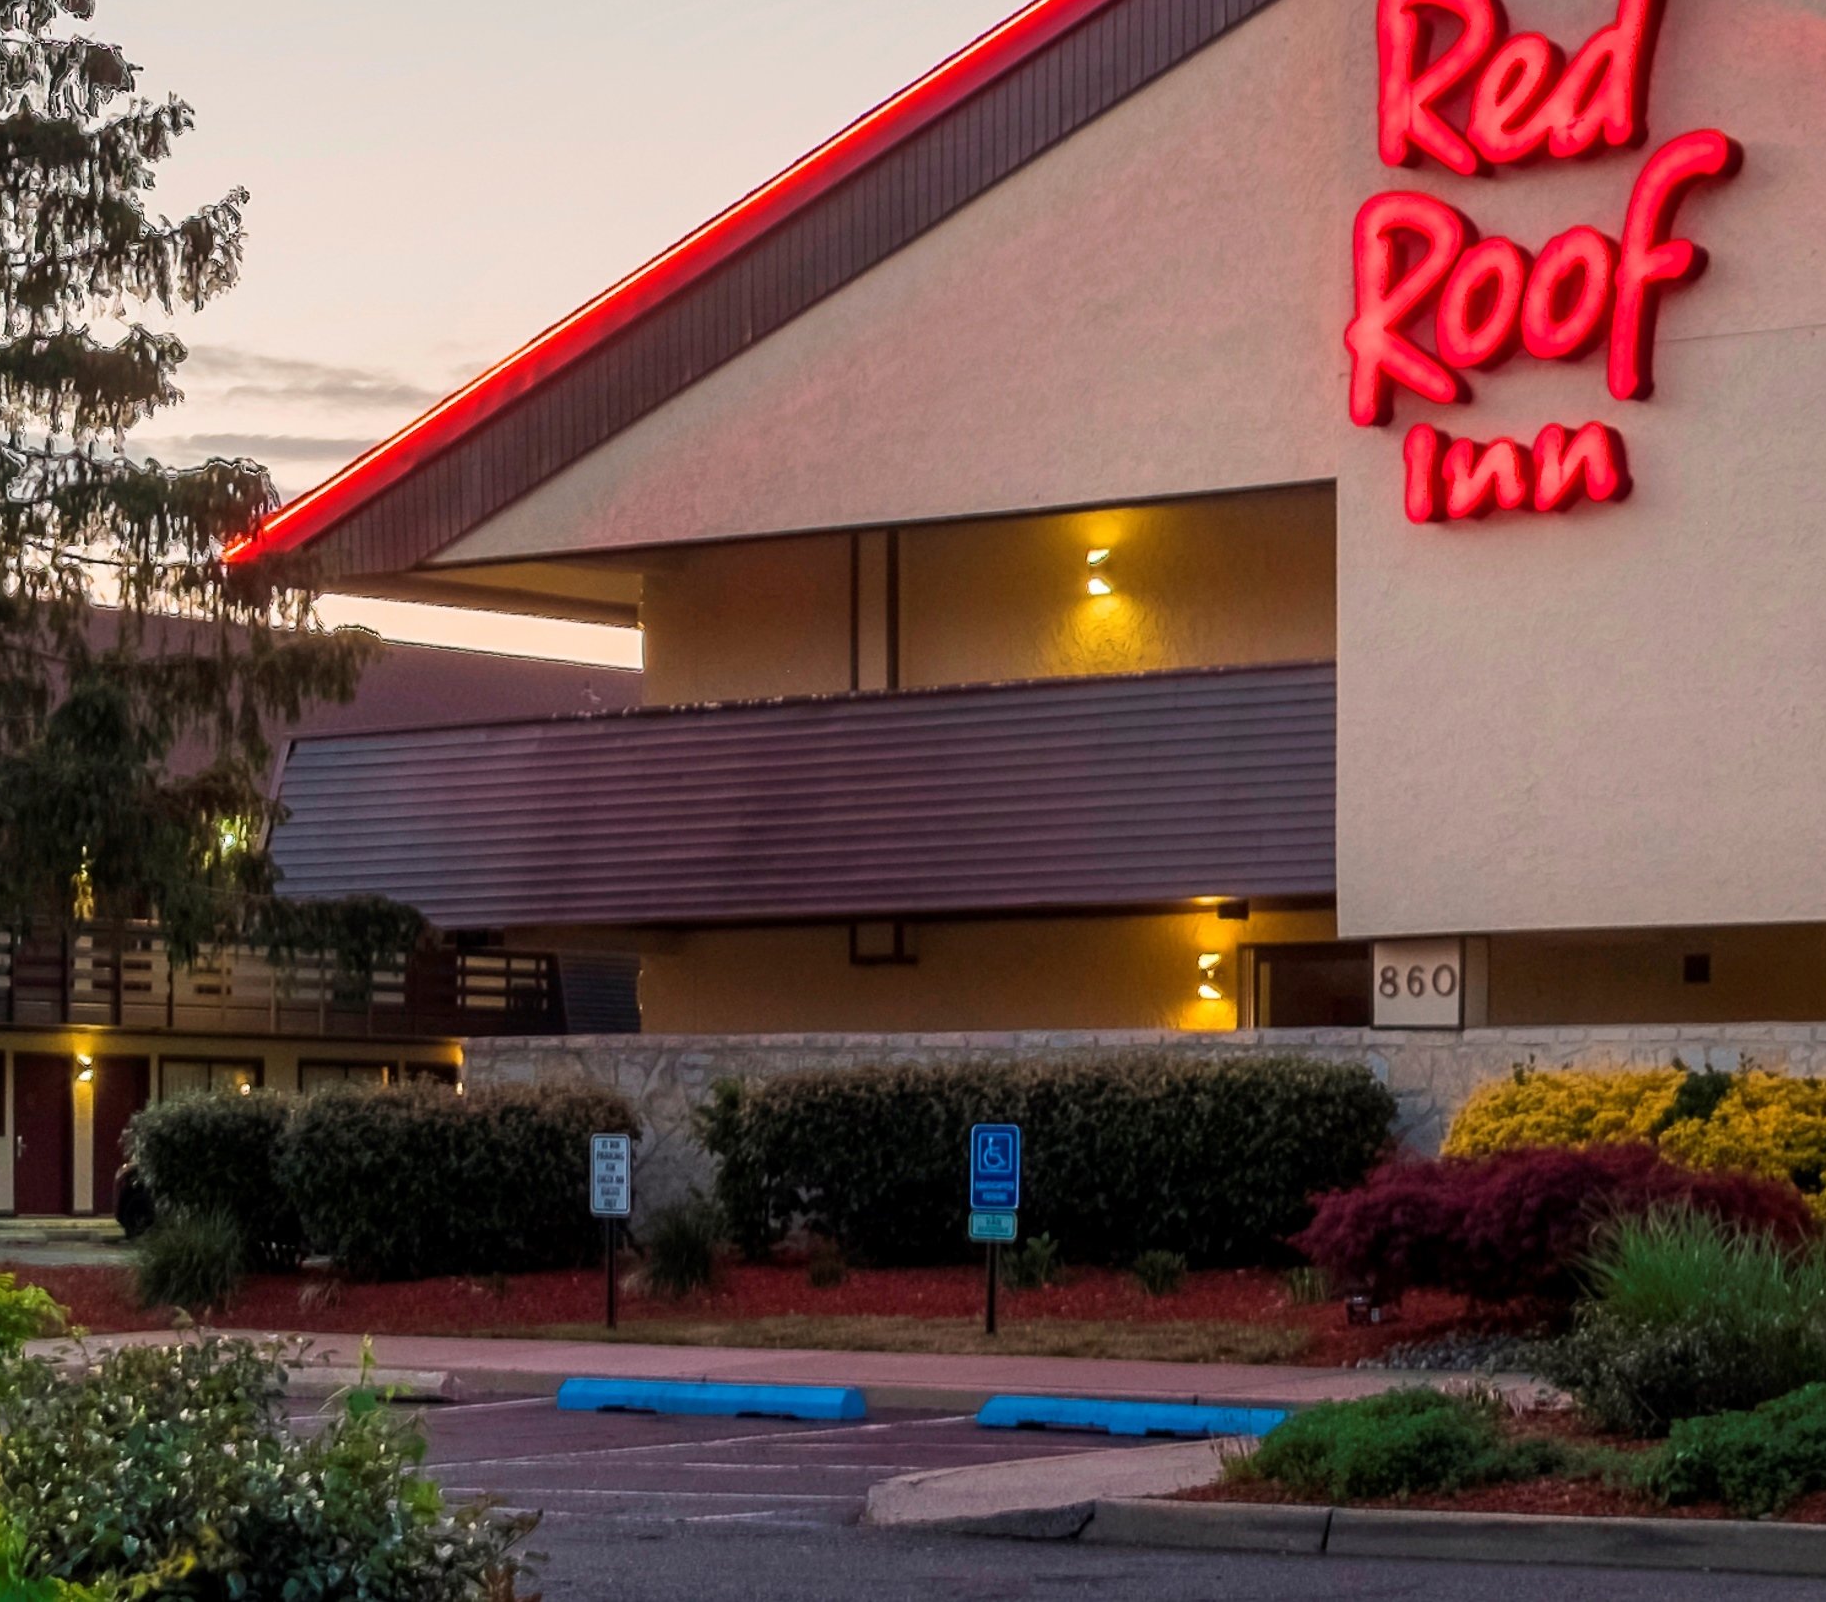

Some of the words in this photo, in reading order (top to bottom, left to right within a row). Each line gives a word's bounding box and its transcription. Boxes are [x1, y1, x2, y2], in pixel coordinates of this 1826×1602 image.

[1343, 129, 1729, 426] Roof
[1402, 420, 1620, 524] Inn
[1379, 964, 1456, 999] 860
